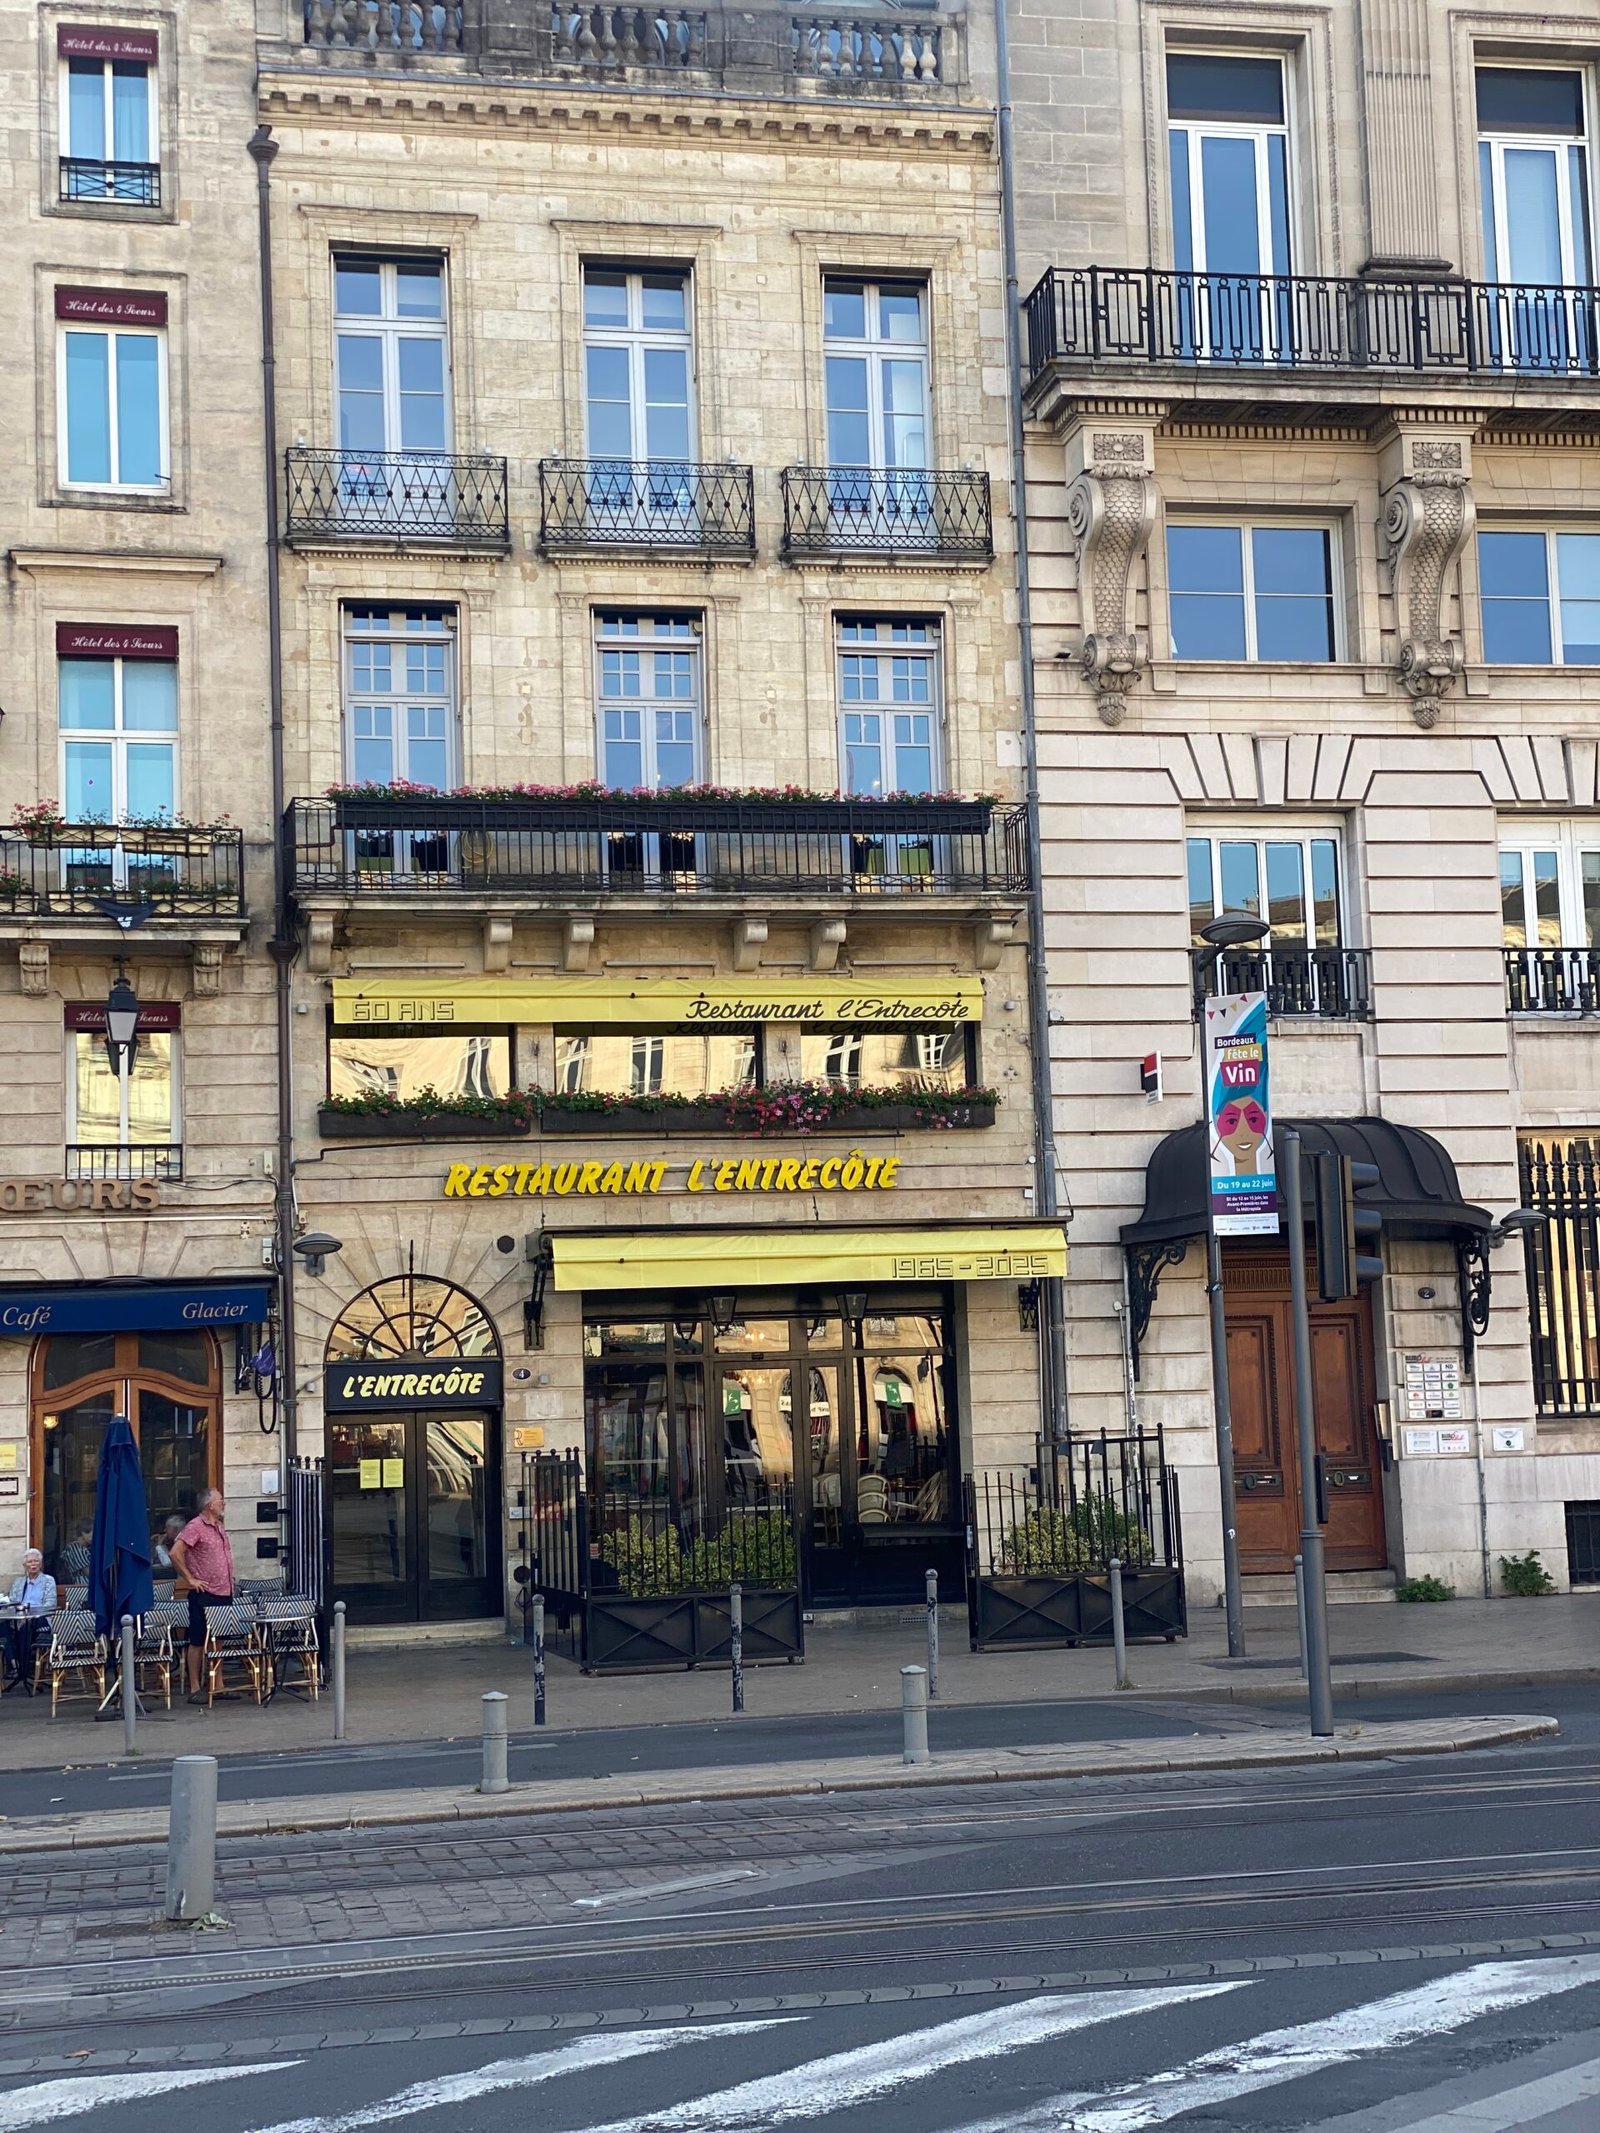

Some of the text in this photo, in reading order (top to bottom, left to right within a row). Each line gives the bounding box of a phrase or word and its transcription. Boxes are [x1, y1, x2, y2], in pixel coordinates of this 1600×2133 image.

[63, 38, 95, 49] Hôtel
[95, 40, 111, 51] des
[66, 300, 98, 311] Hôtel
[98, 302, 114, 313] des
[117, 304, 123, 314] 4
[71, 636, 103, 648] Hôtel
[103, 638, 120, 648] des
[123, 639, 129, 648] 4
[352, 1000, 455, 1021] 60 ANS
[685, 999, 969, 1020] Restaurant l'Entrecôte
[1217, 1037, 1254, 1047] Bordeaux
[1227, 1047, 1259, 1060] fête le
[1225, 1063, 1256, 1083] Vin
[443, 1148, 900, 1198] RESTAURANT L'ENTRECÔTE
[1217, 1181, 1229, 1189] Du
[1231, 1181, 1240, 1189] 19
[1252, 1180, 1260, 1188] 22
[1261, 1179, 1273, 1189] juin
[891, 1258, 953, 1278] 1965
[976, 1255, 1049, 1277] 2025
[2, 1305, 52, 1331] Café
[182, 1302, 249, 1321] Glacier
[342, 1366, 485, 1398] L'ENTRECÔTE
